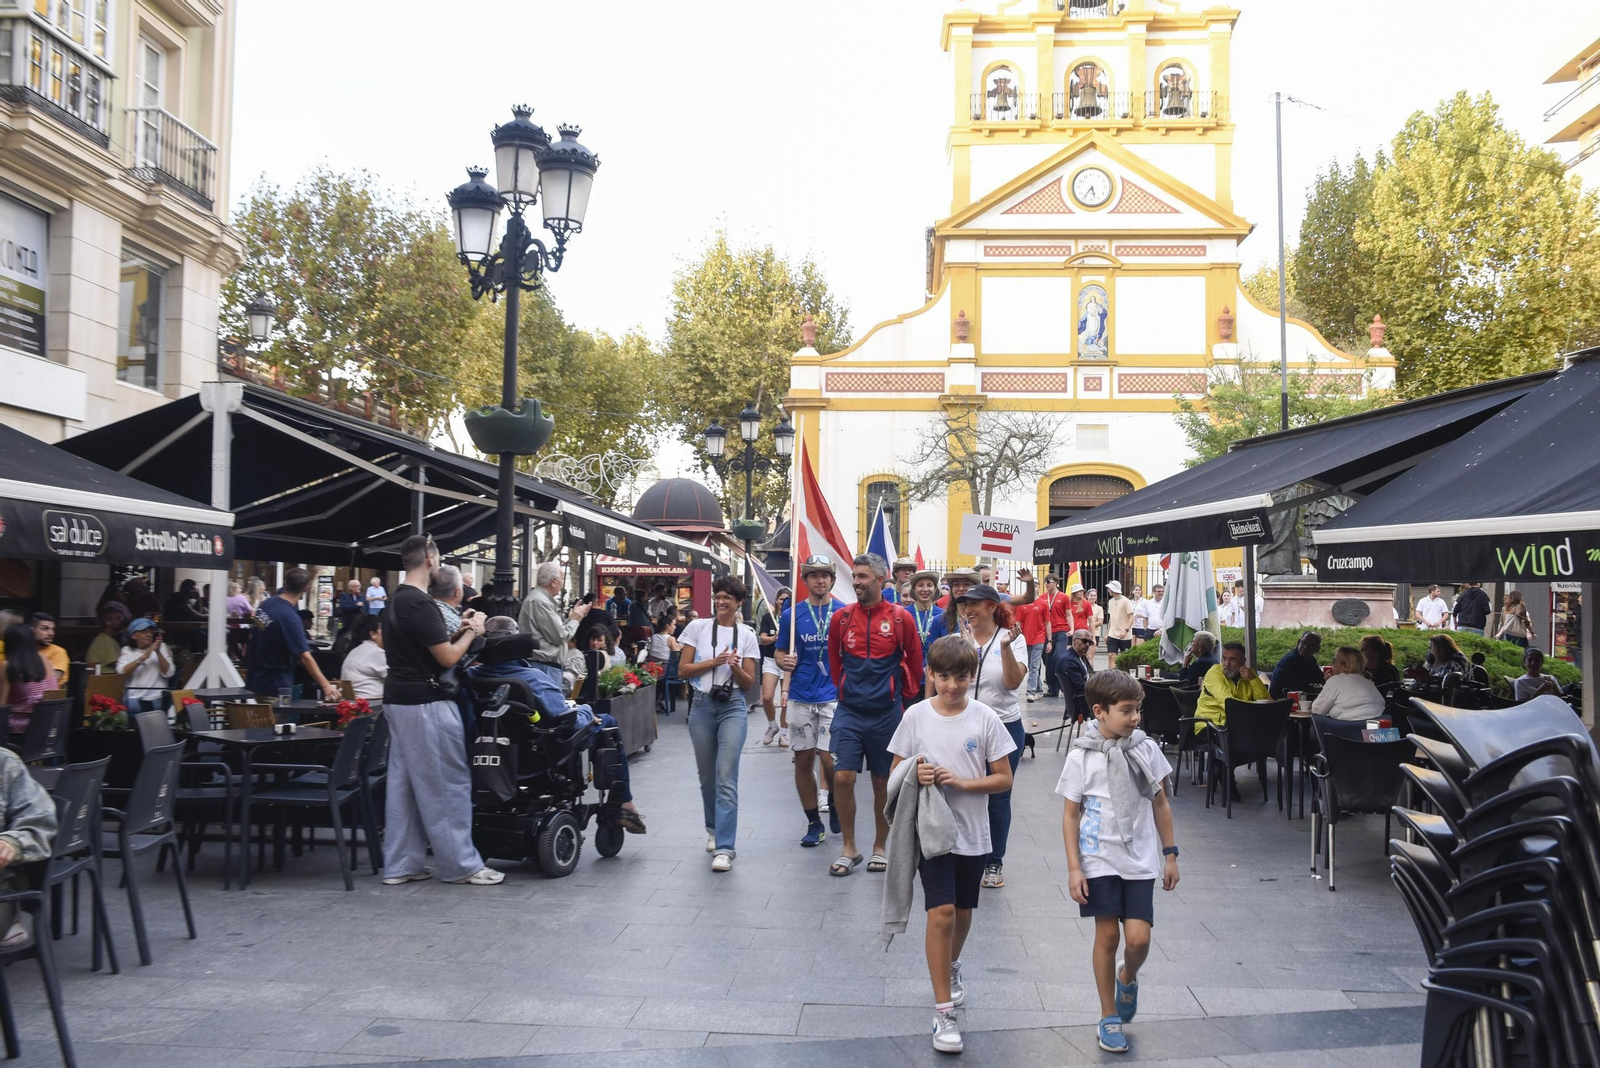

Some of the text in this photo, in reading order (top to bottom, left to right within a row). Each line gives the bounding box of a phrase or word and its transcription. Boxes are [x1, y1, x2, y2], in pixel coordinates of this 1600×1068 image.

[69, 518, 102, 546] dulce
[977, 521, 1020, 535] AUSTRIA
[1230, 521, 1261, 535] Heineken
[1327, 554, 1373, 571] Cruzcampo
[601, 566, 633, 574] KIOSCO
